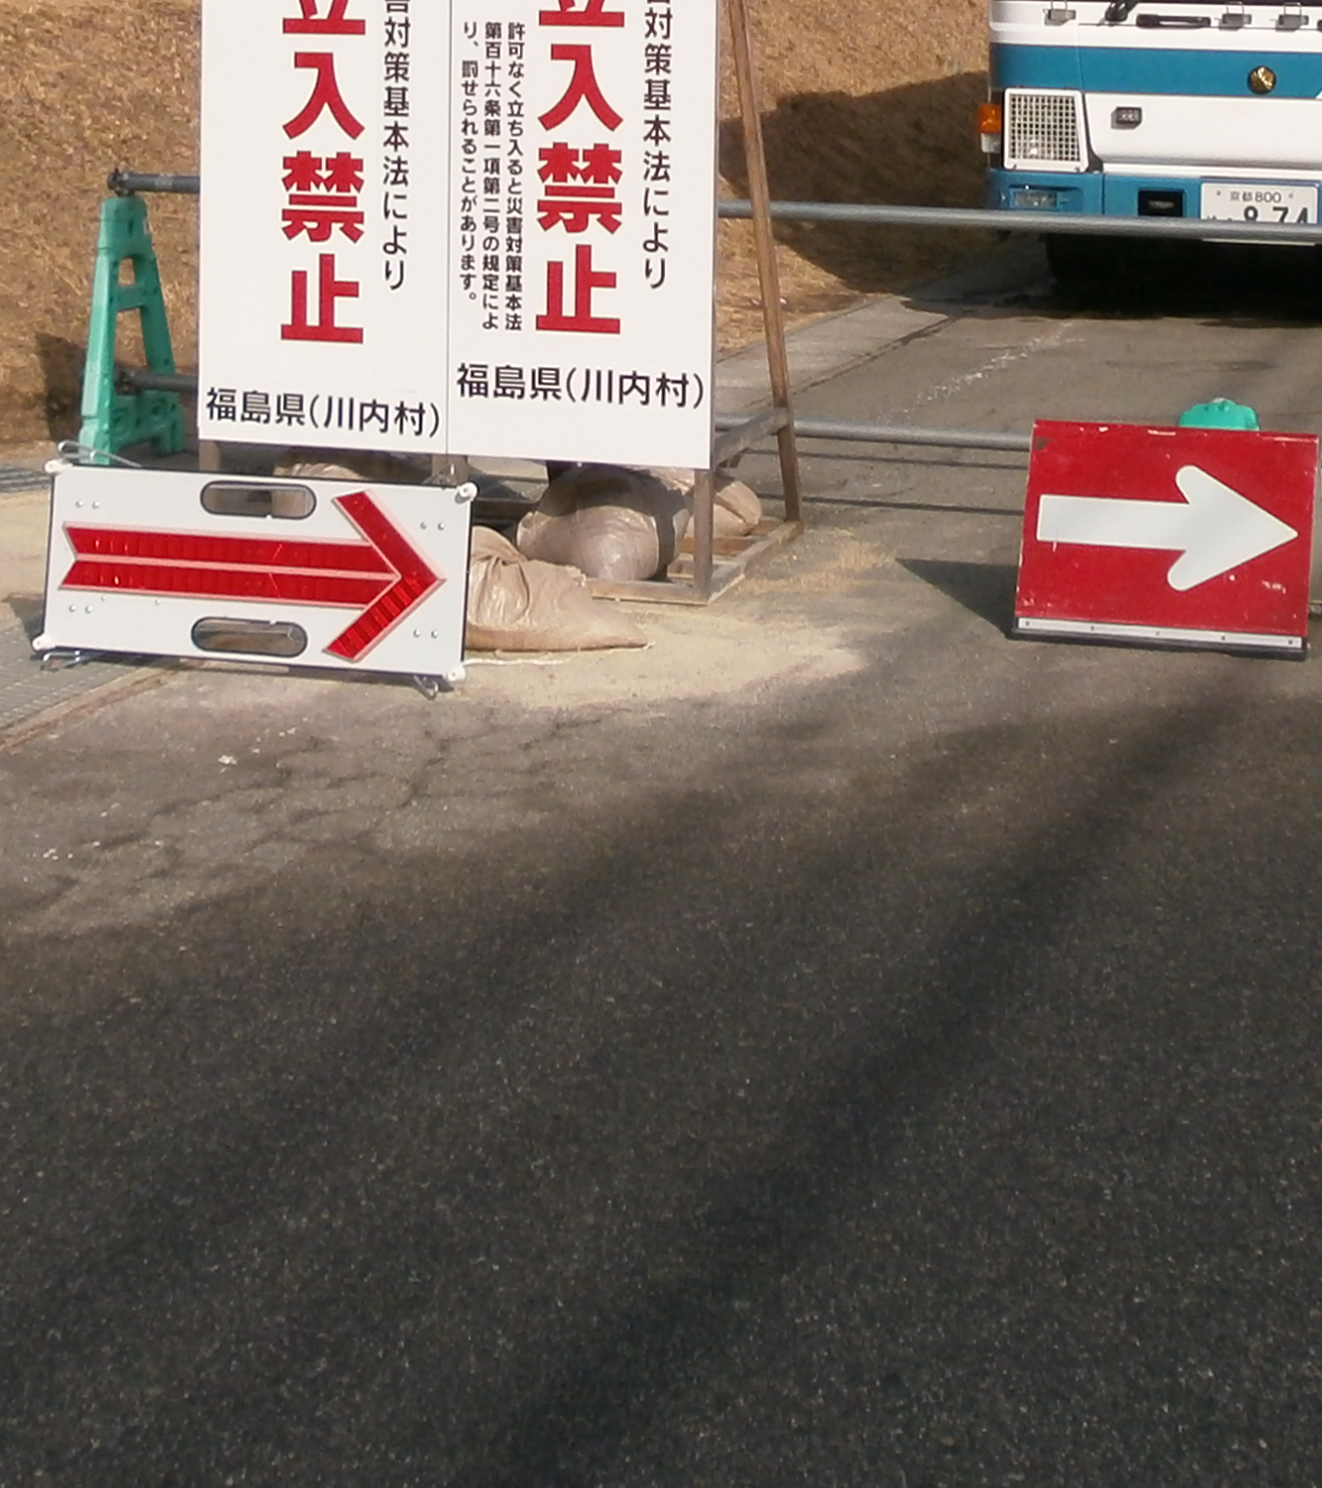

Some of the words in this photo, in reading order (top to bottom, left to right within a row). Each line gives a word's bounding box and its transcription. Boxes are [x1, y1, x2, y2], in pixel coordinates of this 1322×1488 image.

[459, 21, 479, 301] り、罰せられることがあります。
[481, 21, 502, 330] 第百十六条第一項第二号の規定によ
[504, 22, 526, 331] 許可なく立ち入ると災害対策基本法
[205, 387, 440, 438] 福島県(川内村)
[455, 362, 705, 410] 福島県(川内村)
